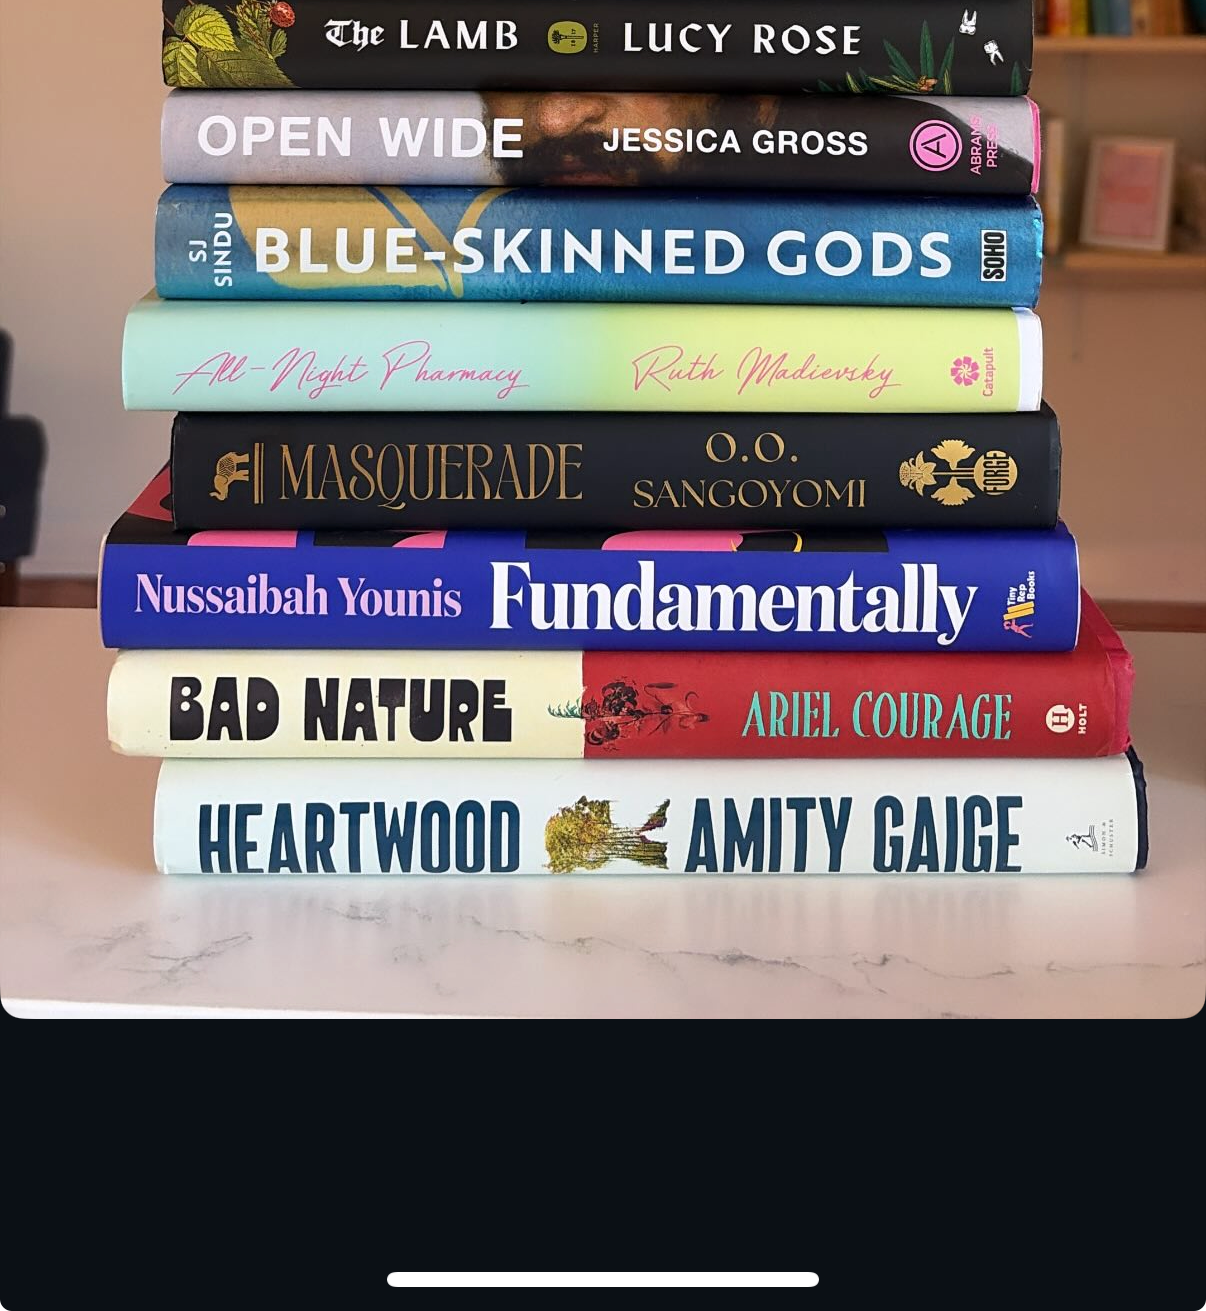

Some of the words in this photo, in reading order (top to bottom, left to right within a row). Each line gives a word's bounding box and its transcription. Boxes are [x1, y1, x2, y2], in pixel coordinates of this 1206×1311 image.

[323, 18, 386, 51] The
[399, 19, 519, 50] LAMB
[623, 22, 732, 54] LUCY
[753, 25, 861, 56] ROSE
[197, 115, 351, 157] OPEN
[379, 117, 524, 158] WIDE
[602, 128, 742, 154] JESSICA
[751, 130, 869, 156] GROSS
[970, 114, 982, 175] ABRAMS
[986, 123, 998, 168] PRESS
[188, 239, 207, 263] SJ
[213, 212, 233, 287] SINDU
[255, 227, 745, 274] BLUE-SKINNED
[766, 230, 952, 278] GODS
[982, 231, 1005, 280] SOHO
[172, 347, 369, 399] All-Night
[379, 339, 531, 400] Pharmacy
[631, 345, 724, 391] Ruth
[735, 346, 902, 398] Madievsky
[982, 347, 996, 397] Catapult
[705, 432, 798, 463] O.O.
[280, 442, 584, 510] MASQUERADE
[633, 479, 866, 508] SANGOYOMI
[134, 574, 328, 616] Nussaibah
[338, 577, 462, 618] Younis
[488, 560, 979, 646] Fundamentally
[1007, 586, 1018, 606] Tiny
[1016, 583, 1028, 602] Rep
[1026, 570, 1036, 600] Books
[169, 676, 280, 741] BAD
[304, 677, 513, 743] NATURE
[741, 690, 840, 738] ARIEL
[852, 691, 1012, 740] COURAGE
[1077, 702, 1088, 735] HOLT
[199, 800, 521, 874] HEARTWOOD
[684, 796, 854, 873] AMITY
[872, 794, 1024, 873] GAIGE
